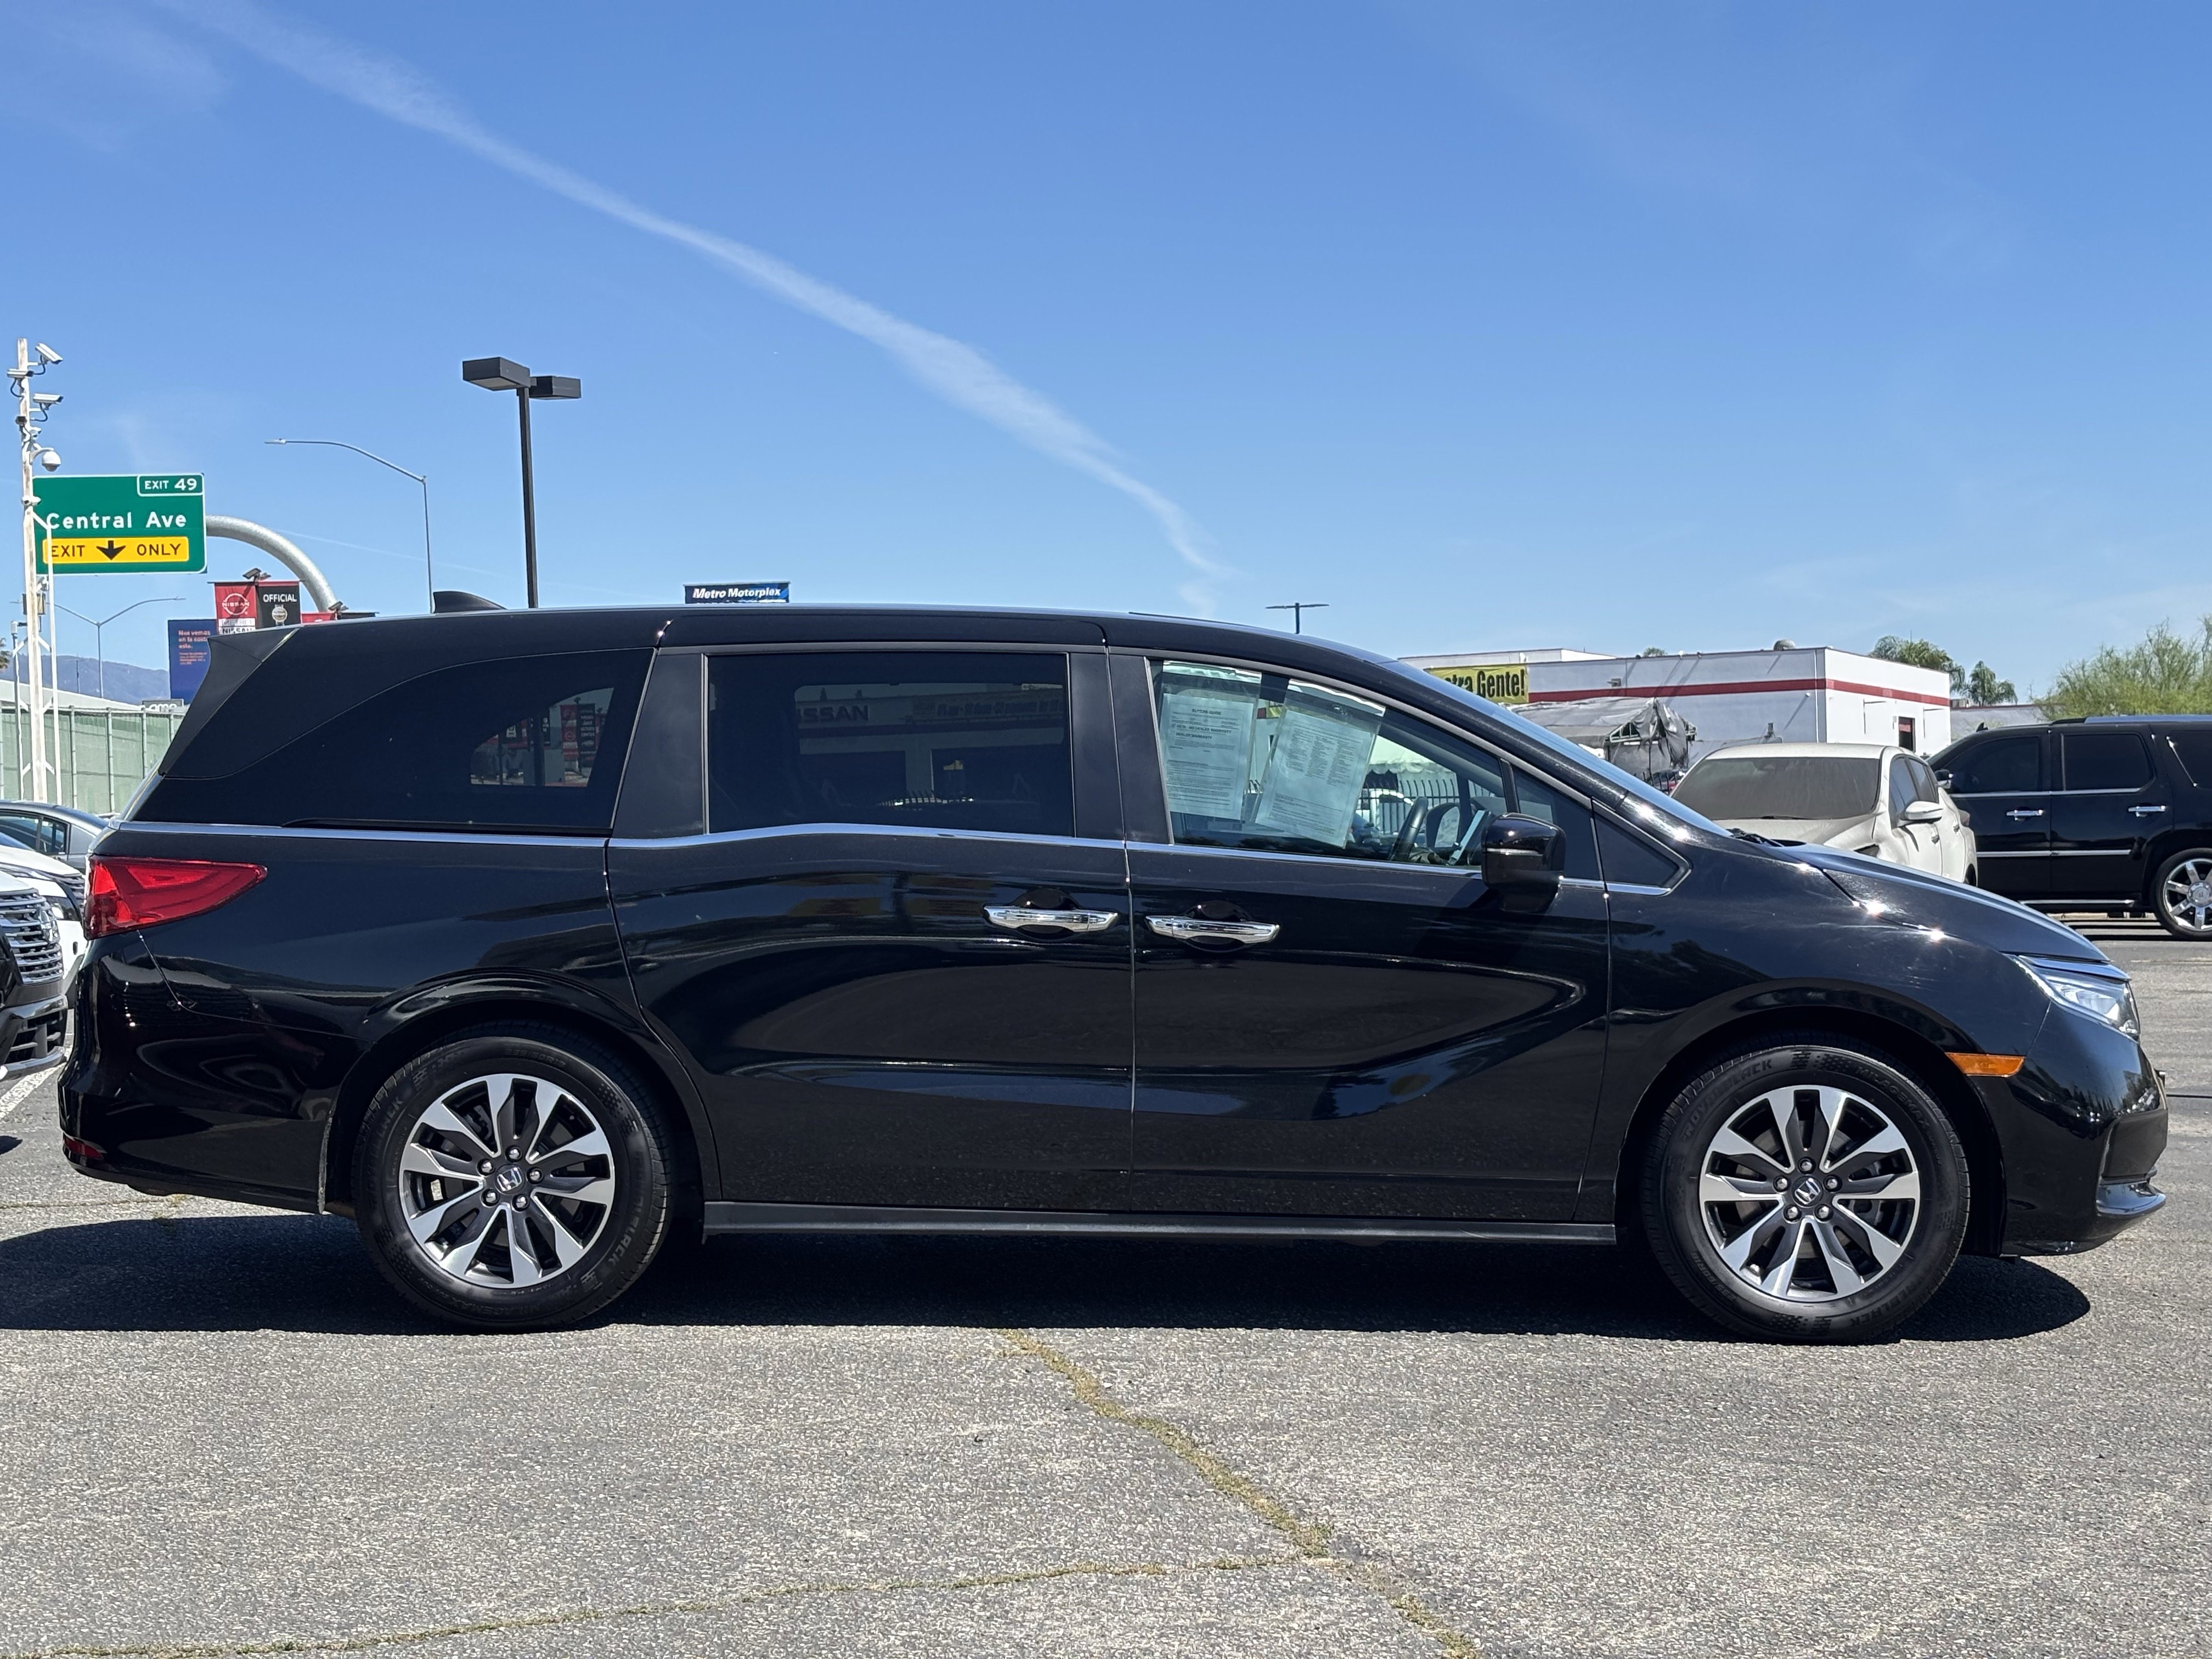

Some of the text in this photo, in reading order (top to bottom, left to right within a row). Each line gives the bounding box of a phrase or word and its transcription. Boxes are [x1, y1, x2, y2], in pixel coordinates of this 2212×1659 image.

[144, 478, 198, 491] EXIT 49
[46, 511, 187, 529] Central Ave
[51, 543, 182, 557] EXIT ONLY
[263, 594, 297, 603] OFFICIAL
[692, 587, 781, 599] Metro Motorplex
[1476, 668, 1525, 699] Gente!
